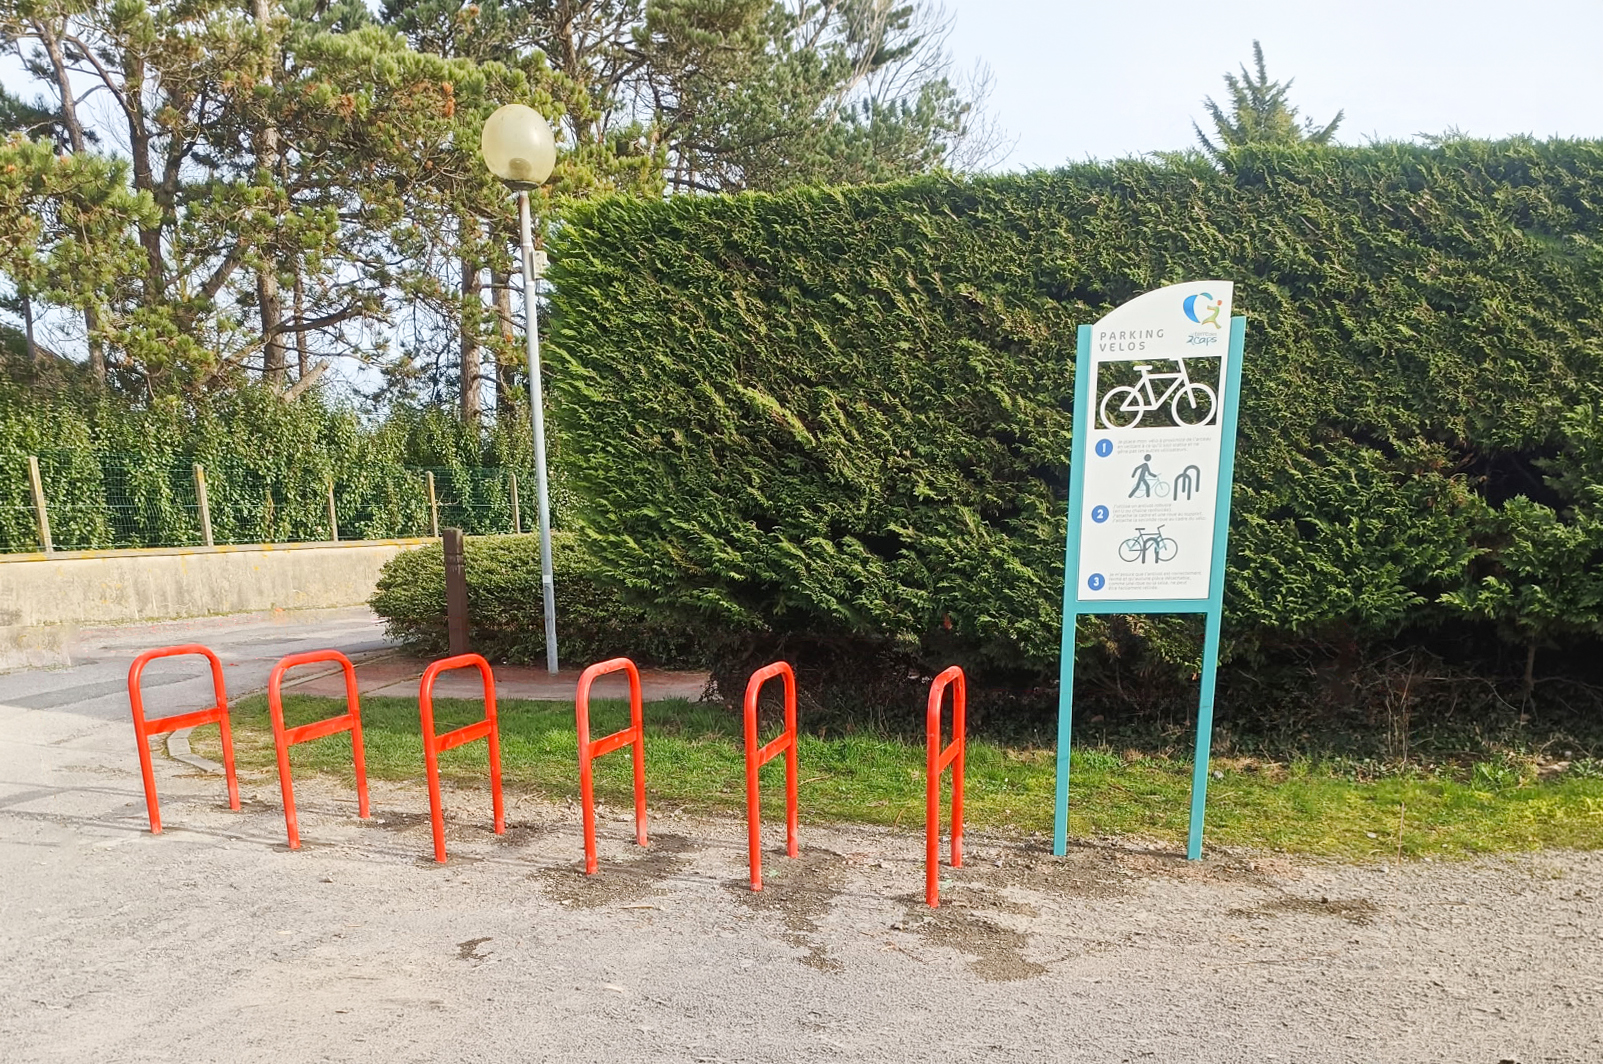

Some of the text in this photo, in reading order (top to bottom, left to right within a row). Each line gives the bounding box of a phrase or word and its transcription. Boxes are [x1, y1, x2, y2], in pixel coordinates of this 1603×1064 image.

[1100, 329, 1164, 341] PARKING
[1099, 341, 1146, 352] VELOS
[1102, 442, 1107, 454] 1
[1096, 509, 1104, 519] 2
[1093, 576, 1100, 587] 3
